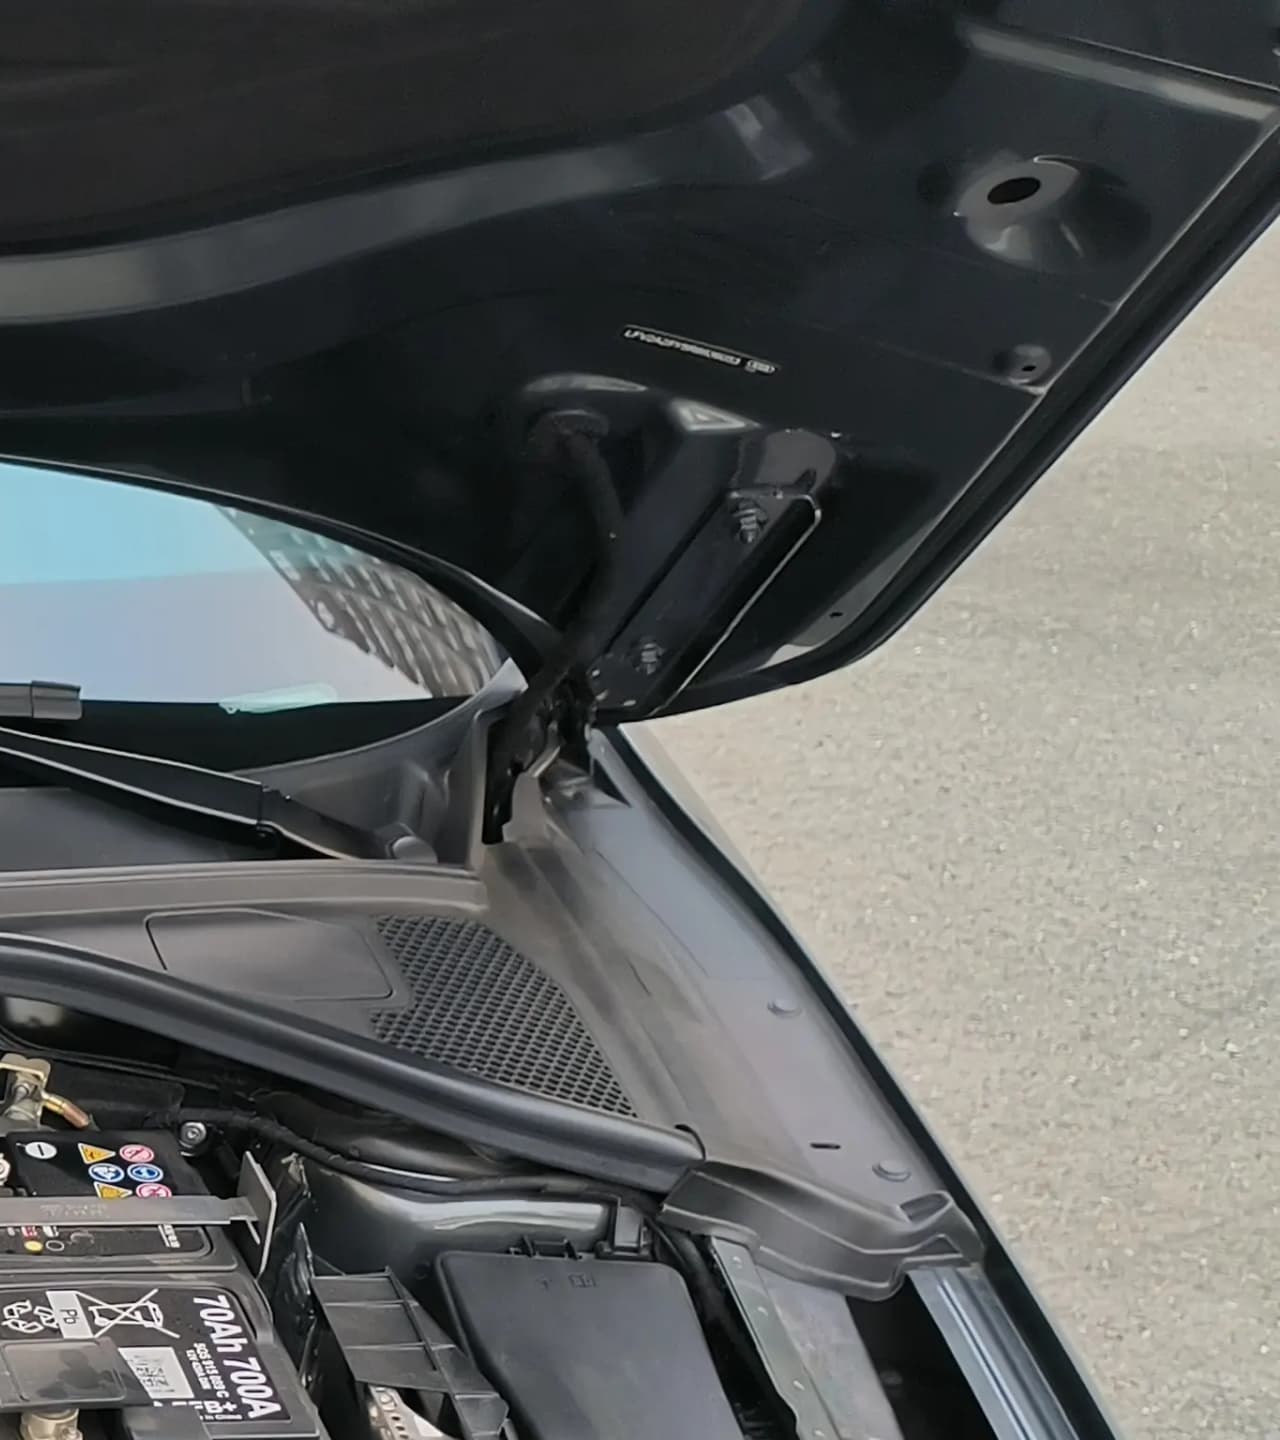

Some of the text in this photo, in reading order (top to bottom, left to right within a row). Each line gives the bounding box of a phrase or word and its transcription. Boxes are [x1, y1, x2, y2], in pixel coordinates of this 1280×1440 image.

[59, 1309, 79, 1325] Pb
[193, 1295, 248, 1352] 70Ah
[223, 1357, 282, 1419] 700A
